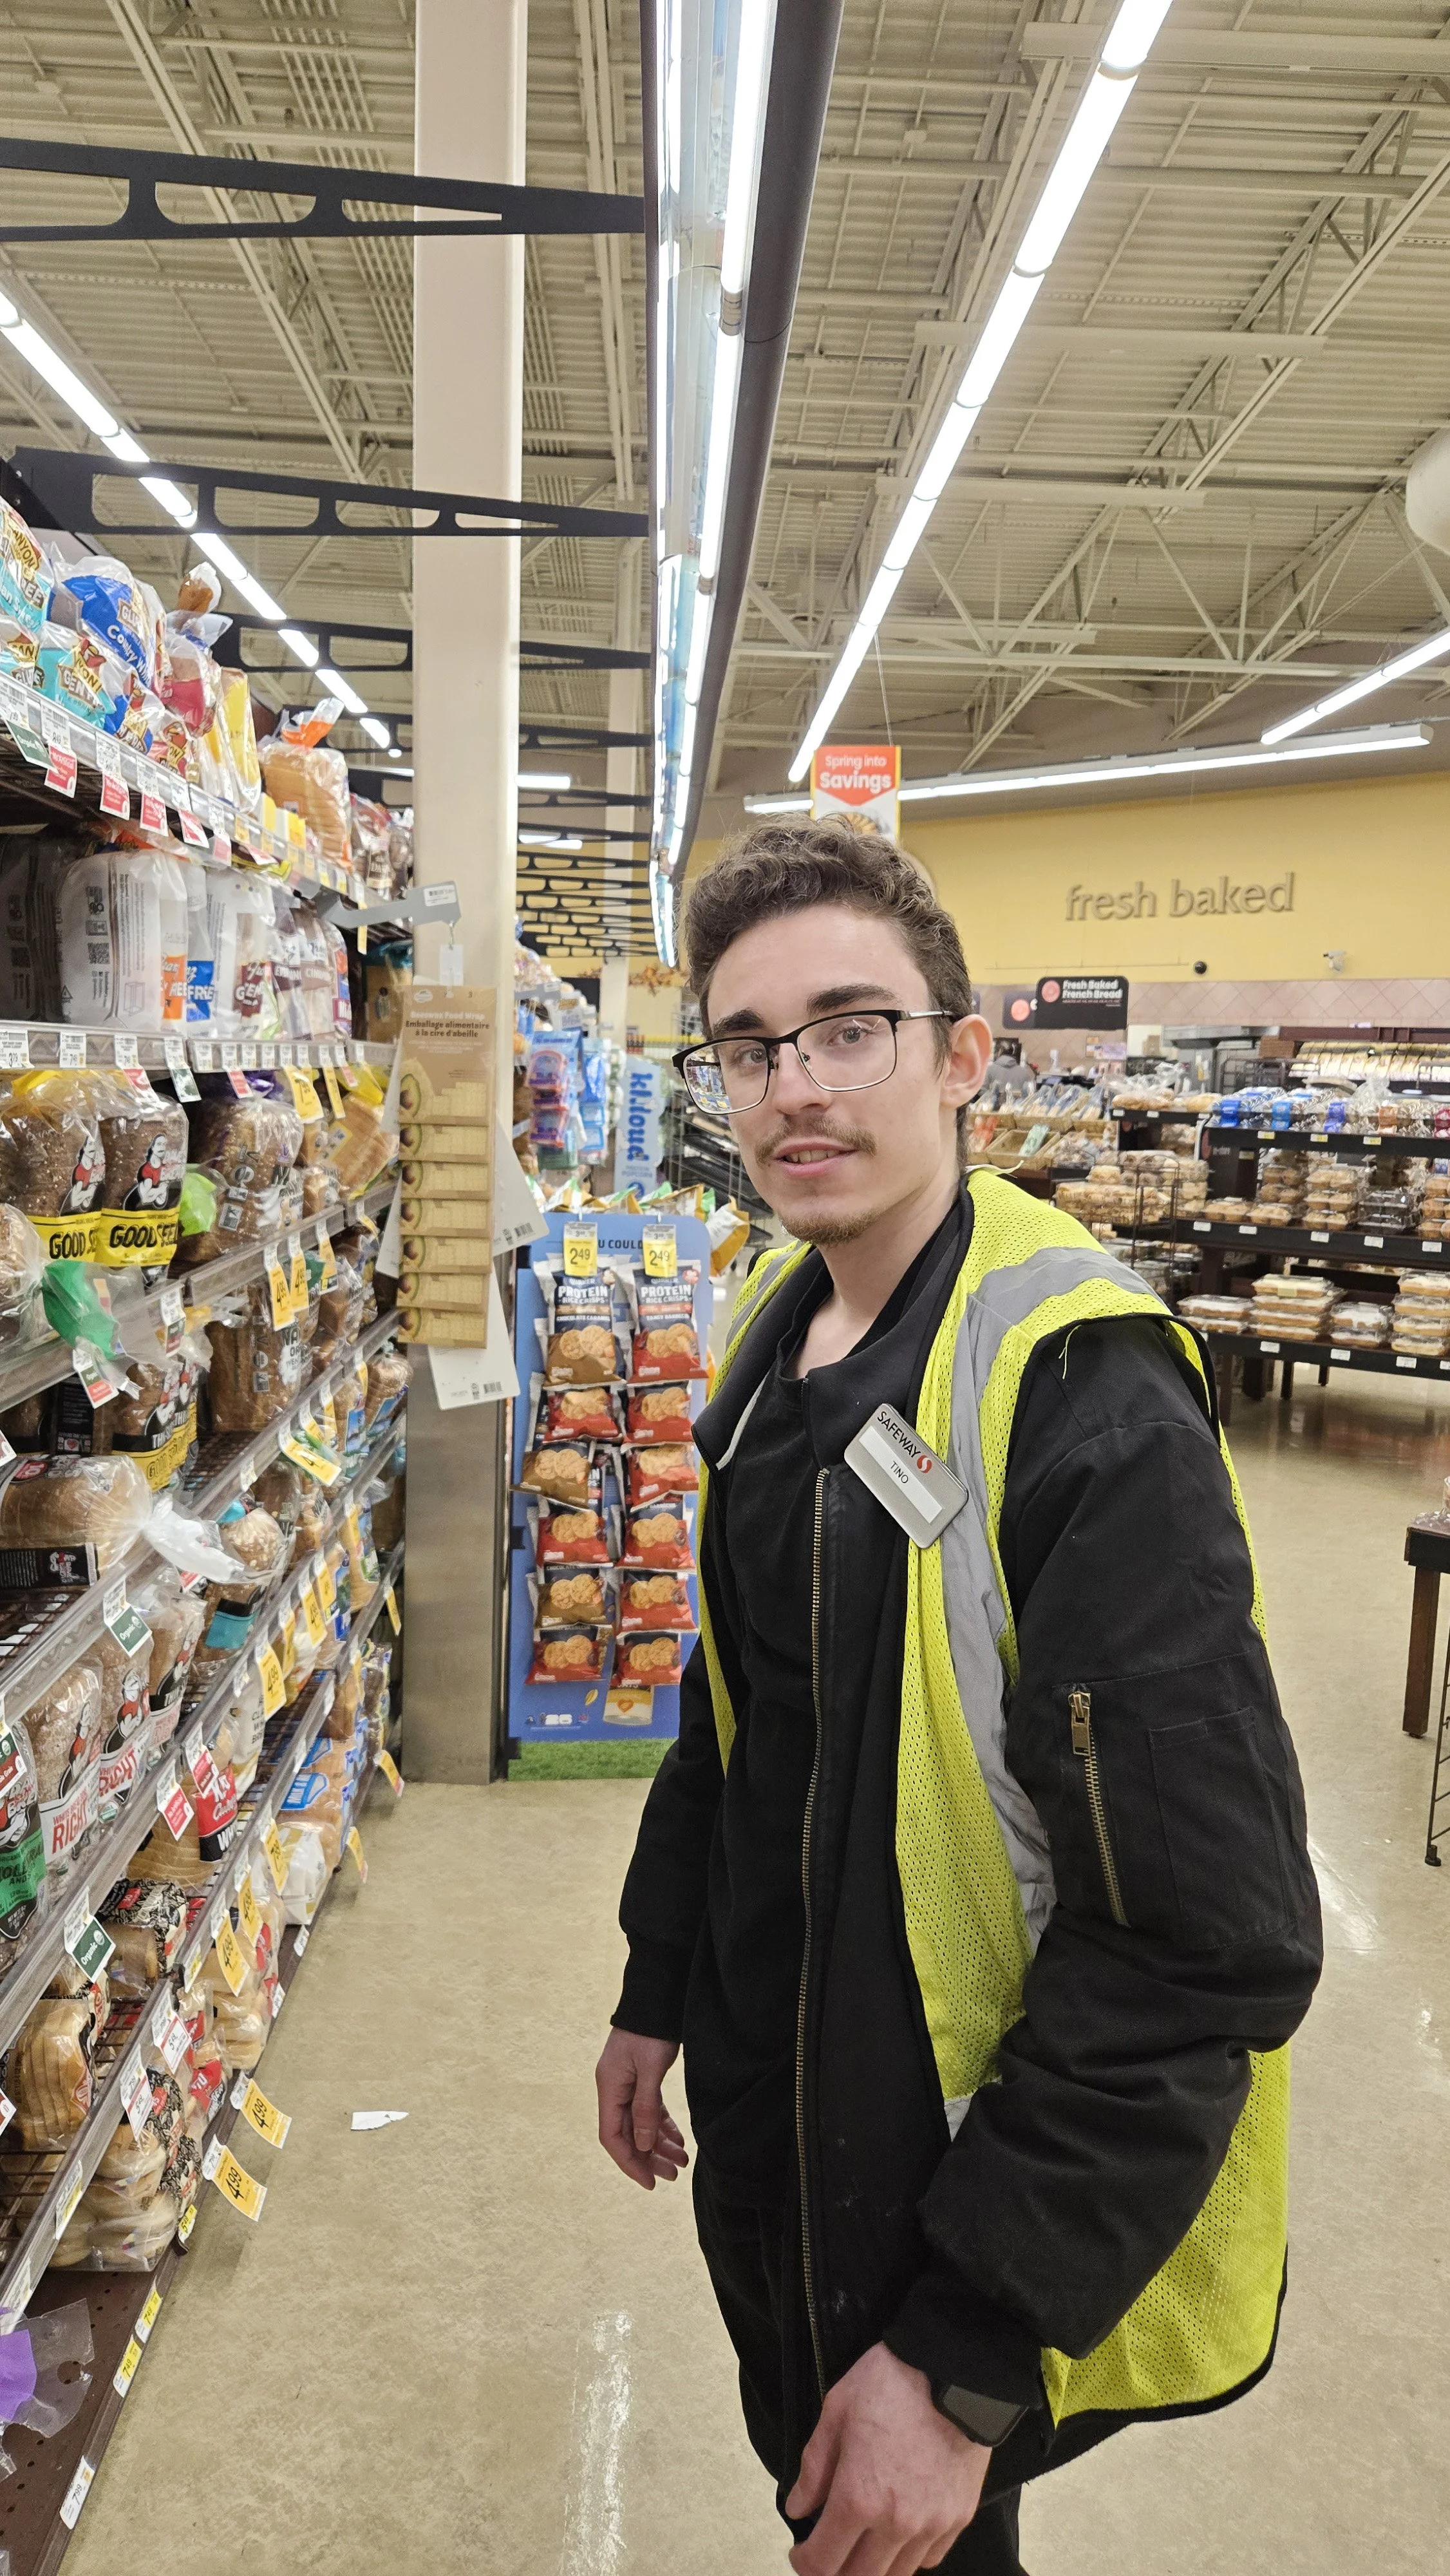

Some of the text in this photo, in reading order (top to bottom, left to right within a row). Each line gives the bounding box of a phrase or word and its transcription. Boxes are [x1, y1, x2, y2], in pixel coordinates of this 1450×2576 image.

[825, 754, 887, 770] Spring into
[820, 769, 892, 794] Savings
[1065, 871, 1296, 921] fresh baked
[1062, 979, 1119, 989] Fresh Baked
[1062, 989, 1124, 998] French Bread
[406, 1020, 490, 1030] Emballage alimentaire
[49, 1230, 86, 1260] GOOD
[109, 1224, 158, 1248] GOOD
[569, 1247, 590, 1265] 249
[648, 1249, 670, 1267] 249
[558, 1285, 608, 1299] PROTEIN
[641, 1284, 692, 1298] PROTEIN
[877, 1410, 921, 1458] SAFEWAY
[890, 1460, 909, 1484] TINO
[119, 1617, 136, 1641] Organic
[52, 1797, 88, 1855] RIGHT
[80, 1940, 98, 1965] Organic
[252, 2098, 268, 2129] 499
[225, 2166, 244, 2200] 499
[144, 2306, 153, 2325] 749
[122, 2358, 132, 2378] 749
[72, 2483, 82, 2506] 799
